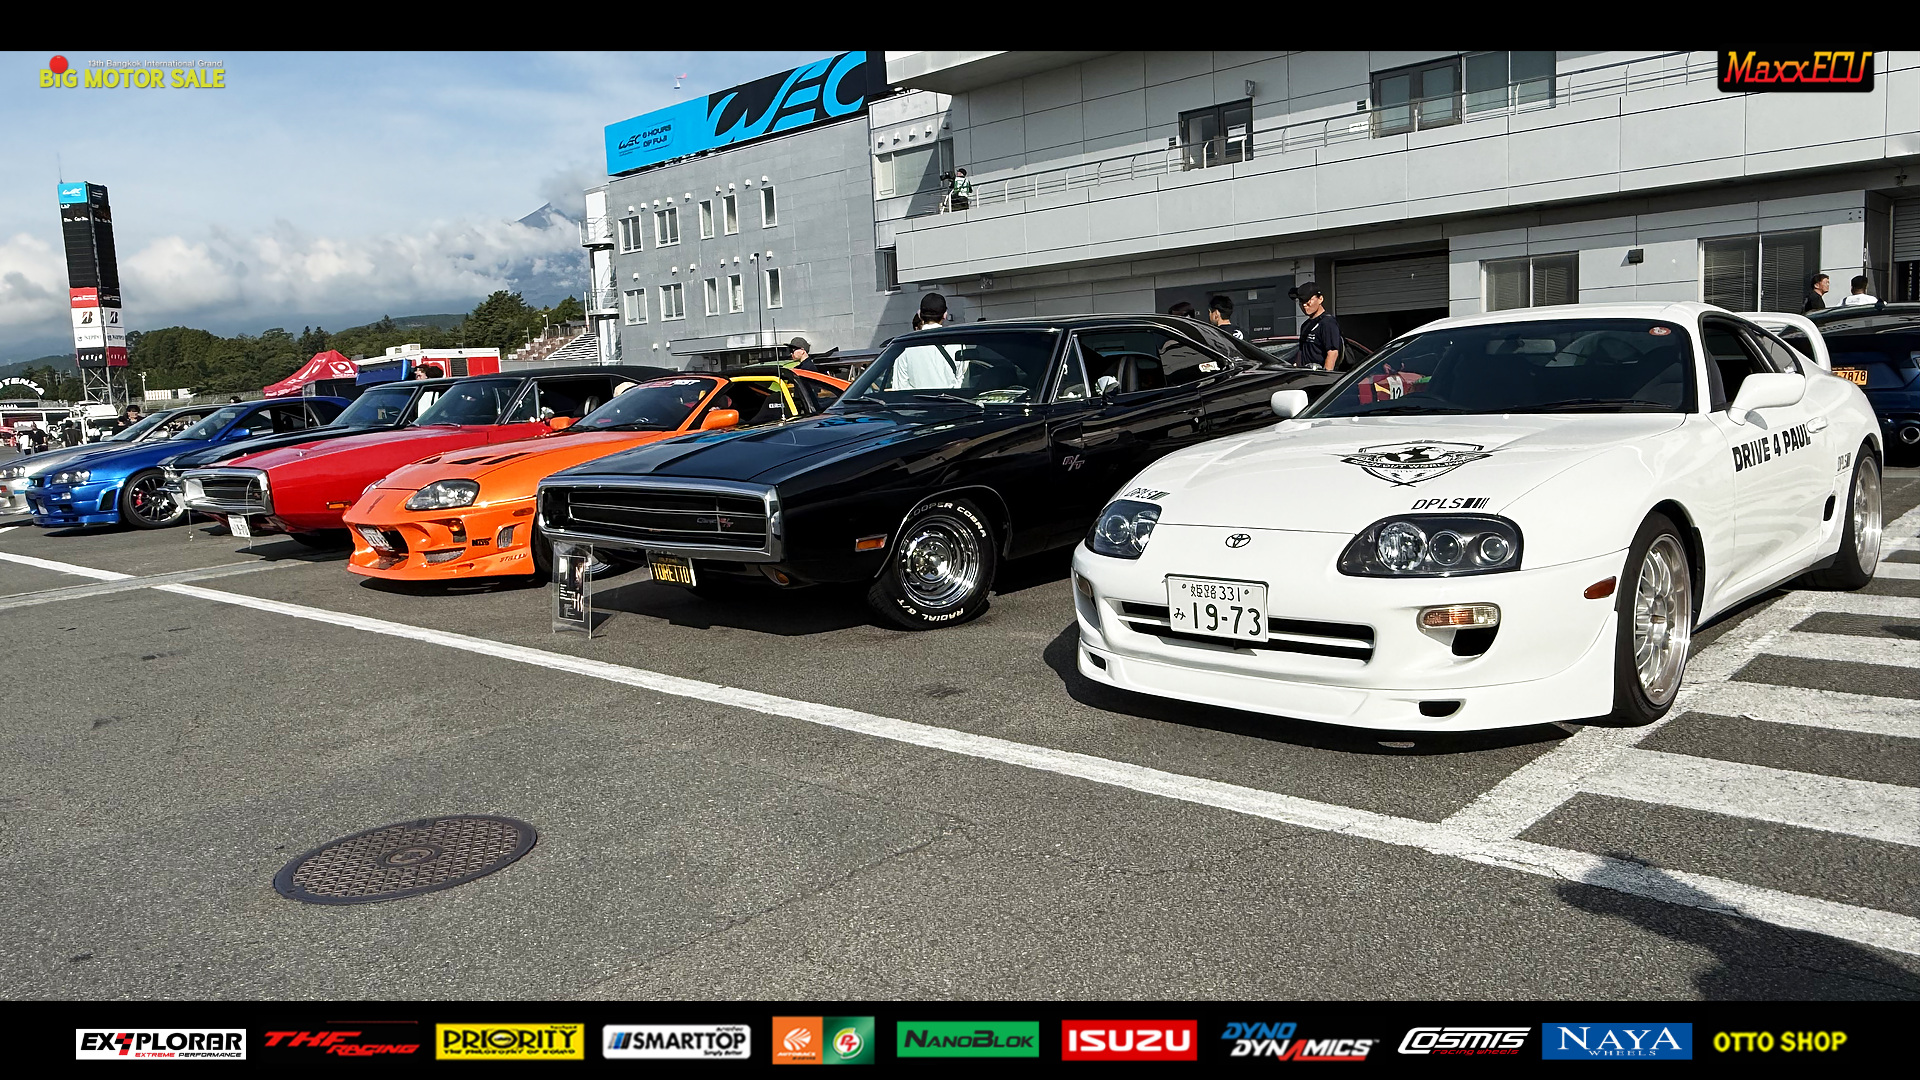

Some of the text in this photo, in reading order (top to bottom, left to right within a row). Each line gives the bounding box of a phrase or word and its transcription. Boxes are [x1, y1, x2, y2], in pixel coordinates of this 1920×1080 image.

[703, 50, 868, 144] WEC
[618, 134, 641, 150] WEC
[1732, 423, 1812, 473] DRIVE 4 PAUL
[1411, 498, 1465, 510] DPLS
[956, 506, 987, 538] COBRA
[652, 562, 691, 584] TORETTO
[921, 608, 964, 622] RADIAL
[1173, 602, 1262, 636] み 19-73
